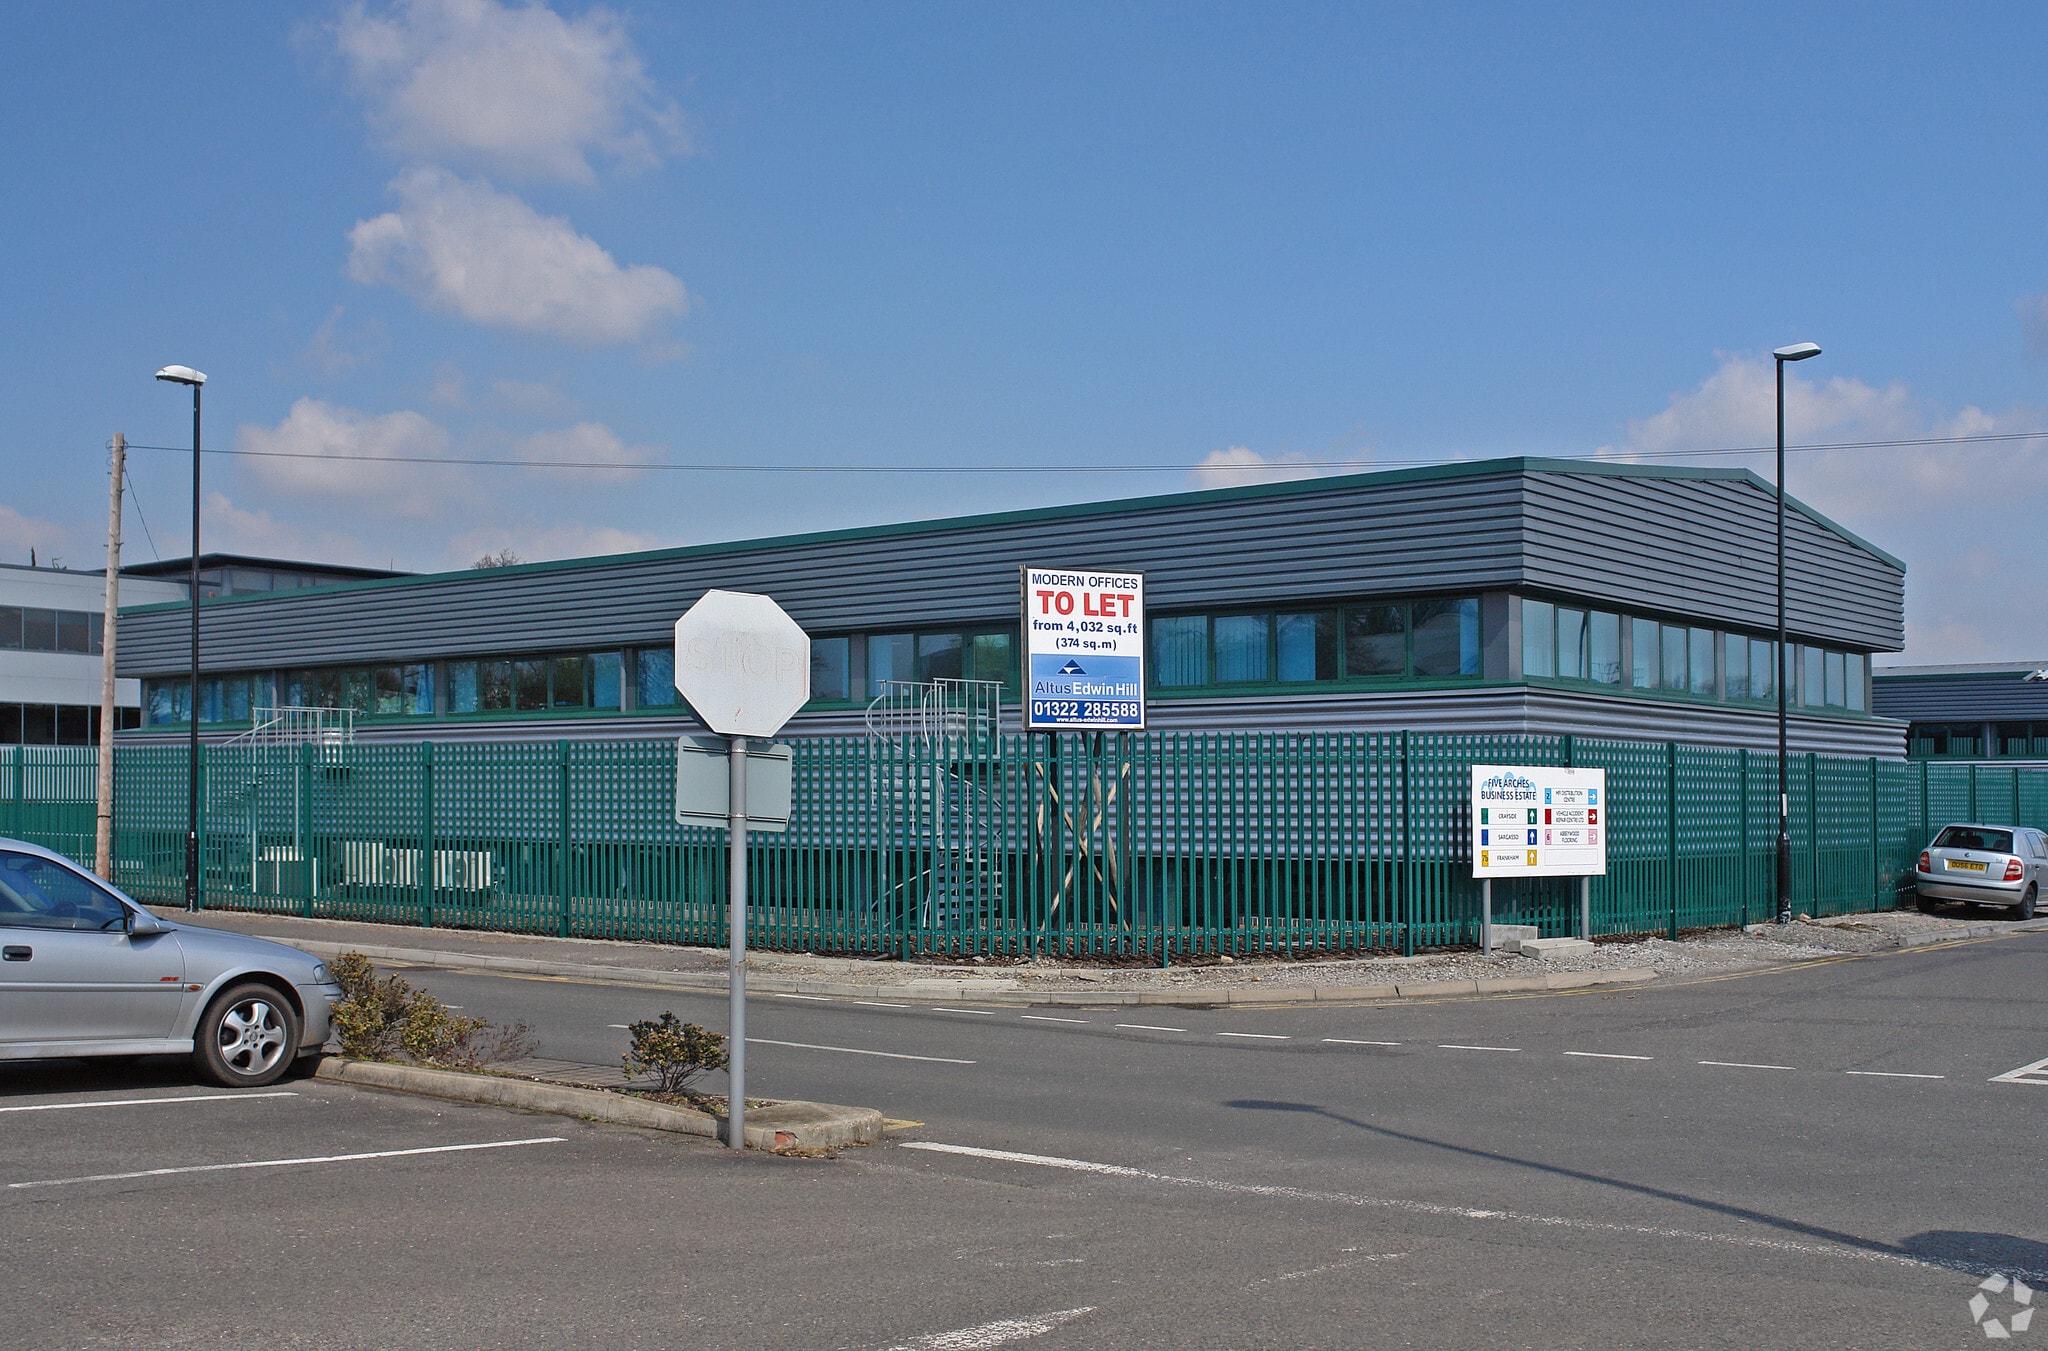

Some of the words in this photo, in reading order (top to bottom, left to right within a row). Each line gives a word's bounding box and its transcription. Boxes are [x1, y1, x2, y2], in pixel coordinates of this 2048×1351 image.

[1032, 573, 1085, 587] MODERN
[1088, 576, 1138, 589] OFFICES
[1036, 590, 1074, 615] TO
[1083, 592, 1135, 618] LET
[1033, 619, 1063, 630] from
[1066, 620, 1103, 633] 4,032
[1107, 623, 1138, 636] sq.ft
[1055, 637, 1080, 649] (374
[1083, 639, 1117, 651] sq.m)
[687, 637, 800, 682] STOP
[1035, 681, 1071, 695] Altus
[1034, 701, 1079, 716] 01322
[1084, 702, 1138, 717] 285588
[1488, 778, 1502, 788] FIVE
[1503, 778, 1530, 788] ARCHES
[1481, 790, 1514, 800] BUSINESS
[1515, 791, 1537, 801] ESTATE
